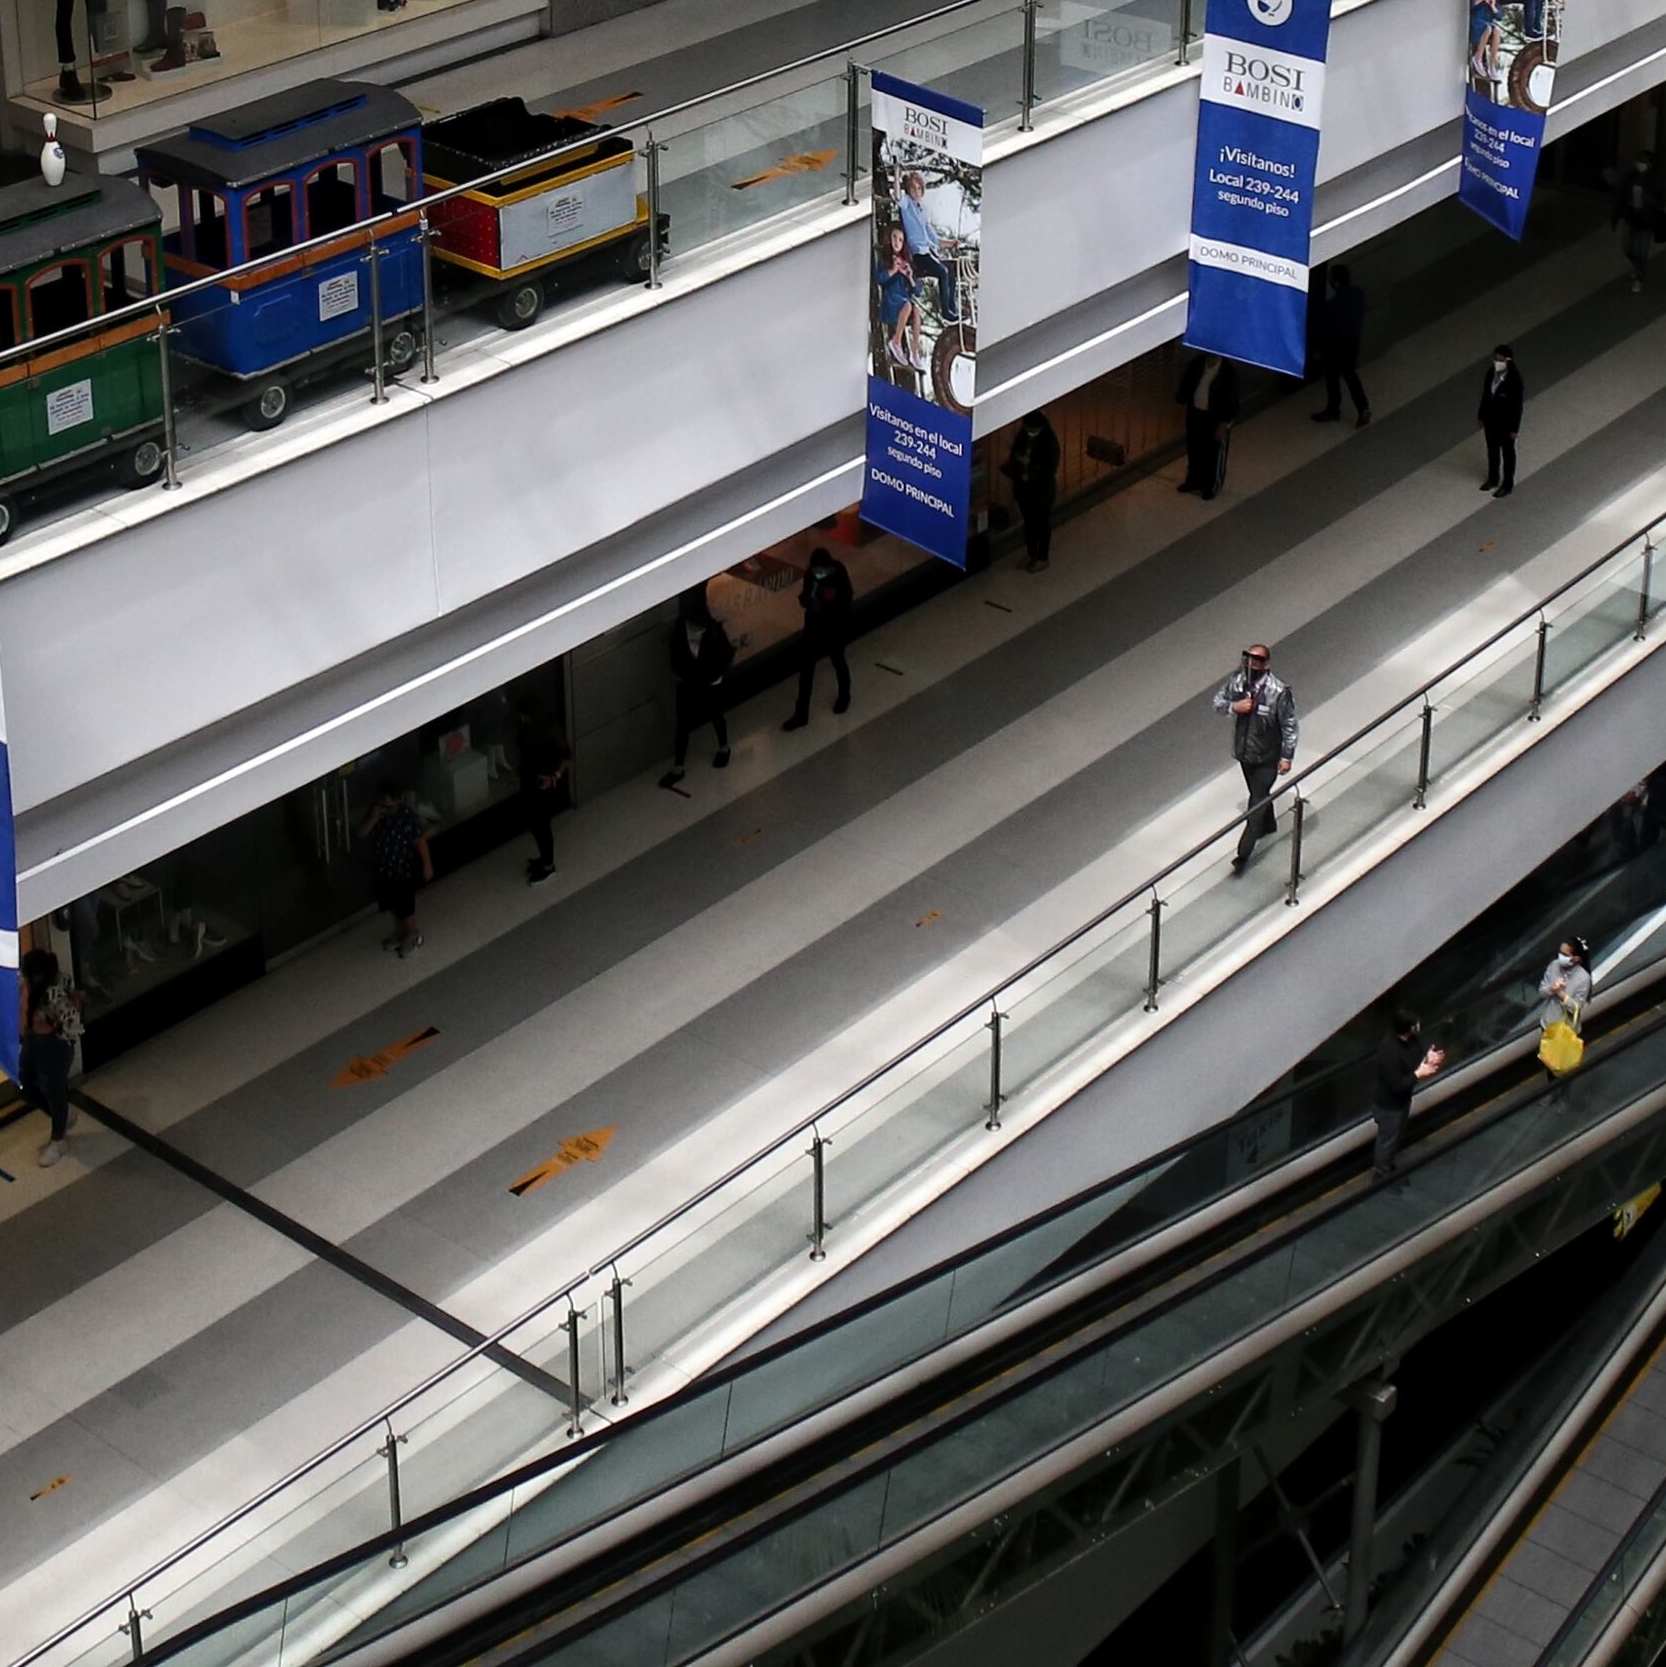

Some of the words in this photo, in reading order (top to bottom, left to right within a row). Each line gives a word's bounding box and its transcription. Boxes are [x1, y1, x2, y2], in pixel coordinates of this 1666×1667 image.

[1224, 51, 1305, 92] BOSI
[1223, 75, 1304, 113] BAMBINO
[903, 106, 949, 136] BOSI
[1509, 130, 1535, 148] local
[1219, 145, 1296, 178] ¡Visítanos!
[1209, 169, 1244, 189] Local
[1244, 177, 1300, 204] 239-244
[1217, 189, 1265, 211] segundo
[1265, 200, 1290, 219] piso
[1200, 245, 1240, 264] DOMO
[1241, 253, 1298, 280] PRINCIPAL
[894, 429, 937, 460] 239-244
[914, 426, 928, 441] en
[928, 431, 939, 446] el
[938, 433, 964, 457] local
[887, 445, 923, 471] segundo
[923, 462, 942, 479] piso
[871, 467, 905, 493] DOMO
[905, 483, 955, 518] PRINCIPAL
